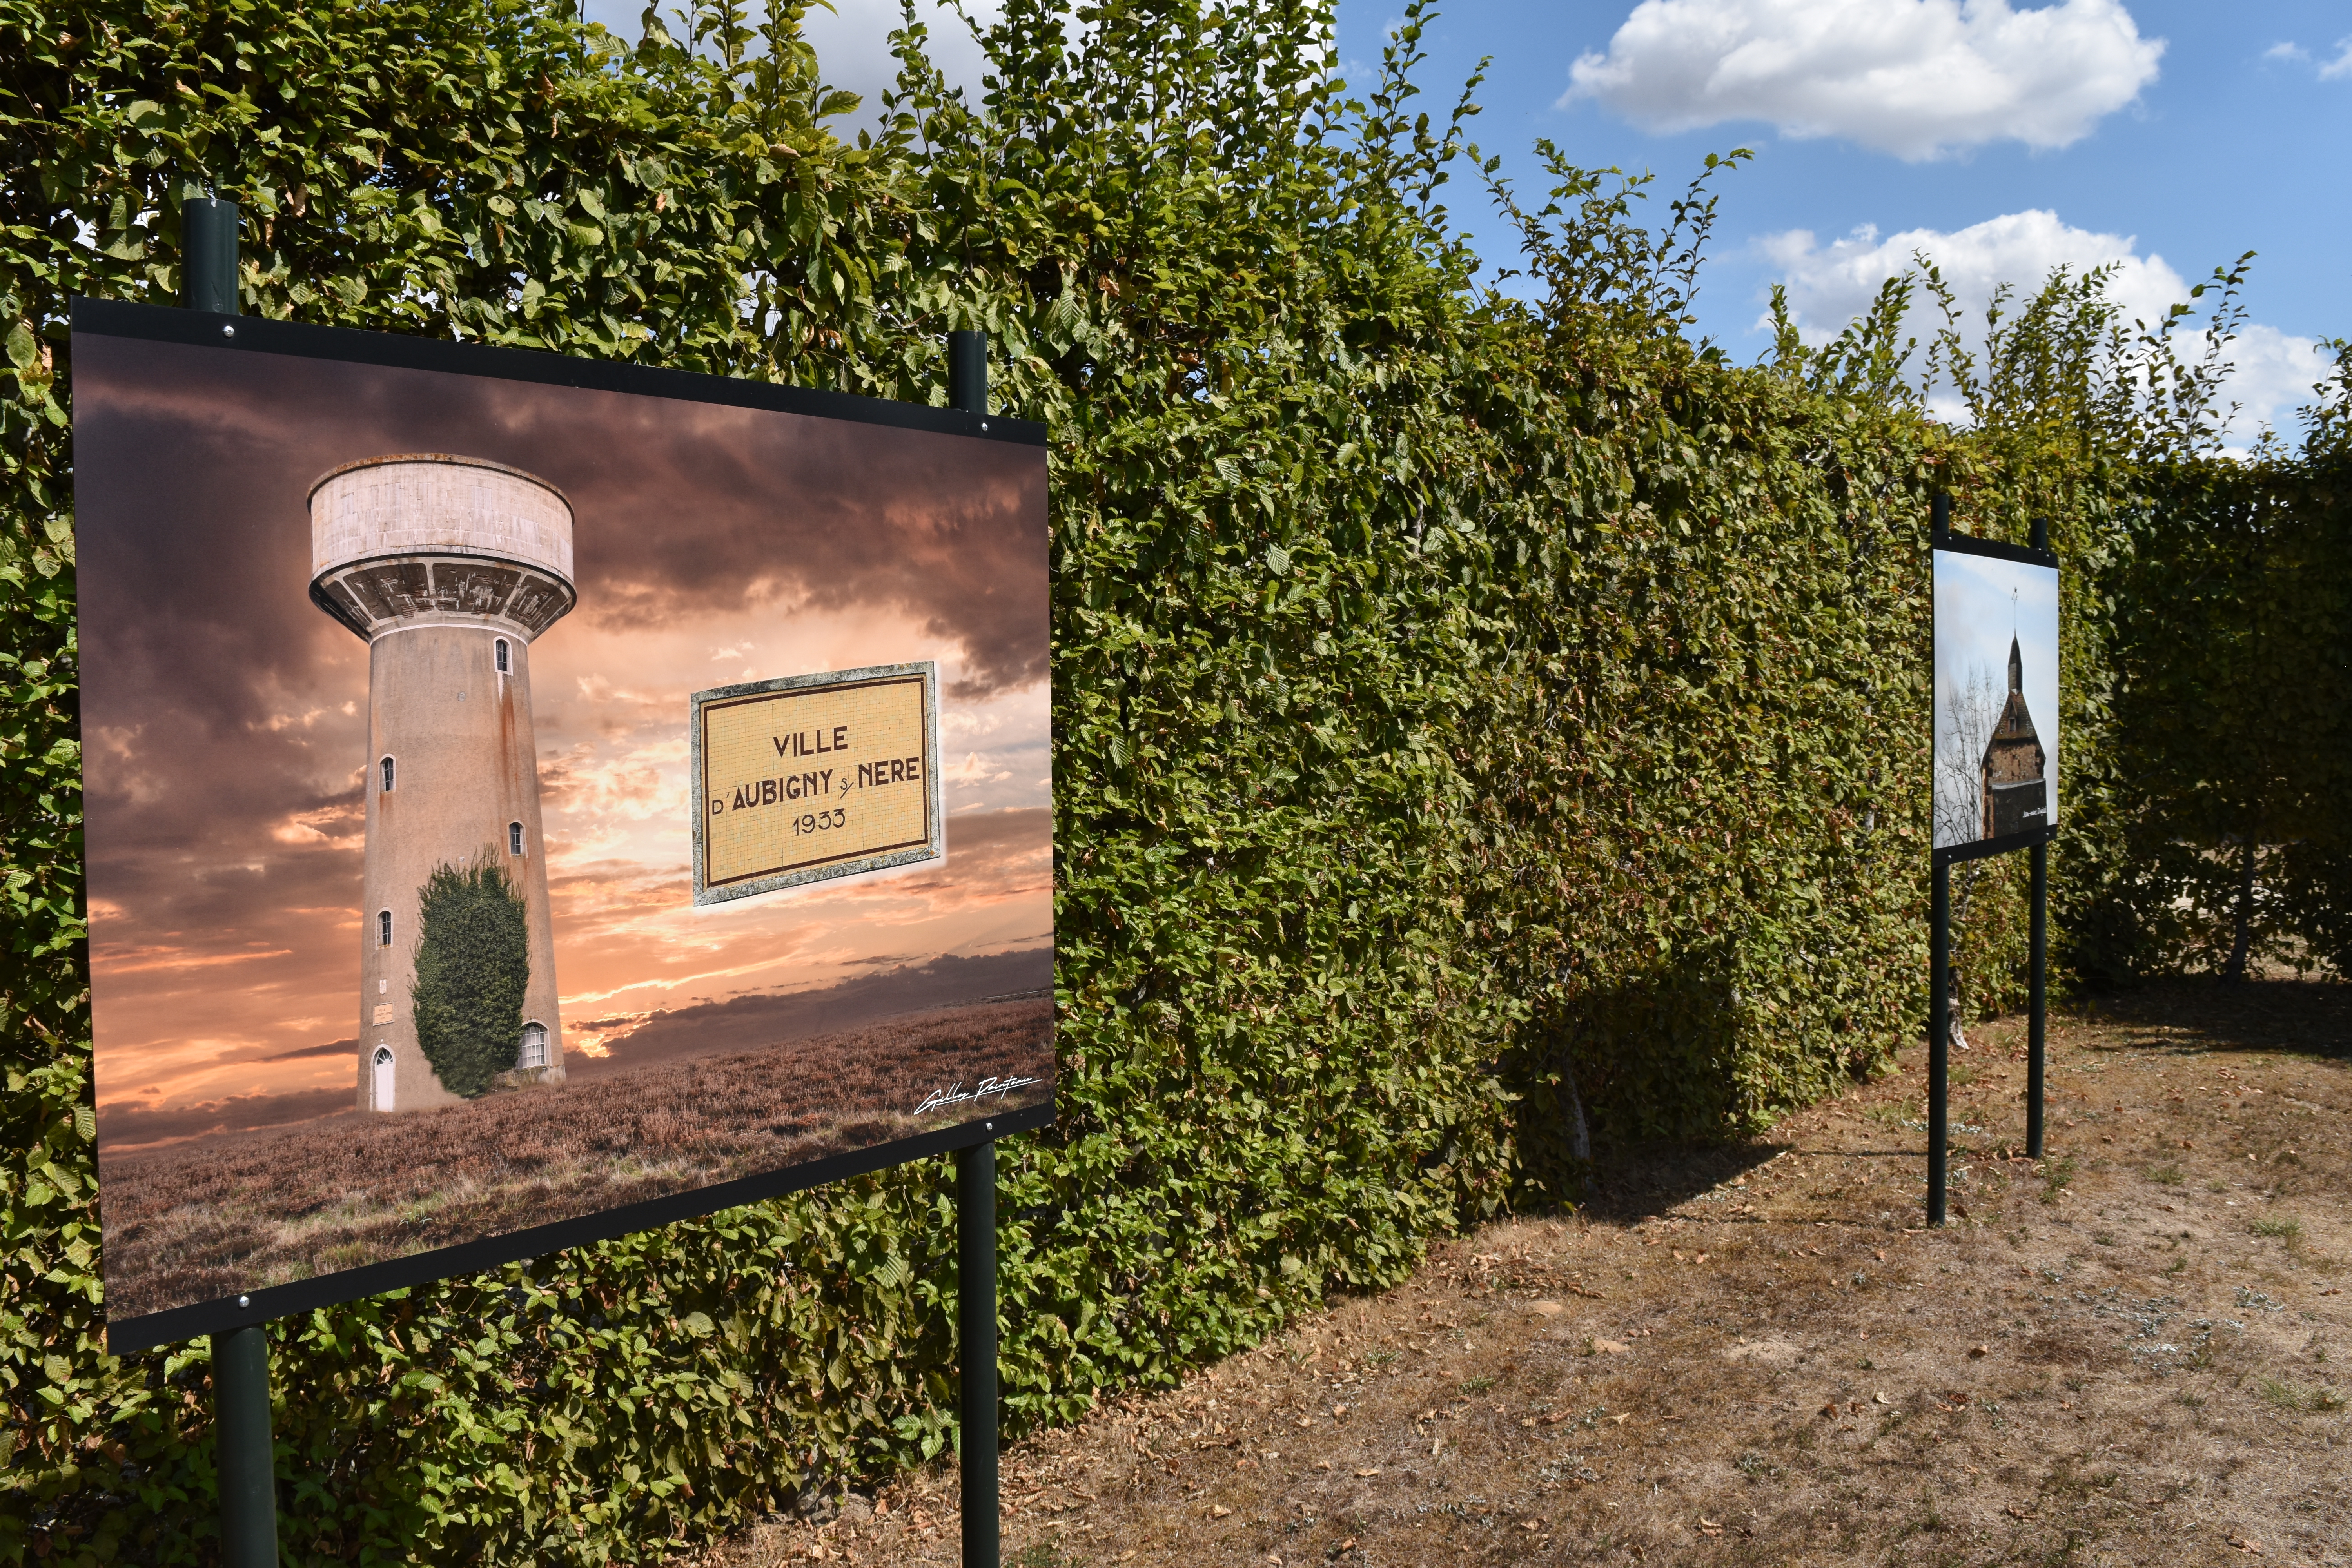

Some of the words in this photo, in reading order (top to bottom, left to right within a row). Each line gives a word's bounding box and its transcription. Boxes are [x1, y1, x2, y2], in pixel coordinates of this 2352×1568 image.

[773, 726, 848, 758] VILLE
[712, 769, 833, 815] D'AUBIGNY
[858, 757, 920, 788] NERE
[793, 808, 845, 836] 1933
